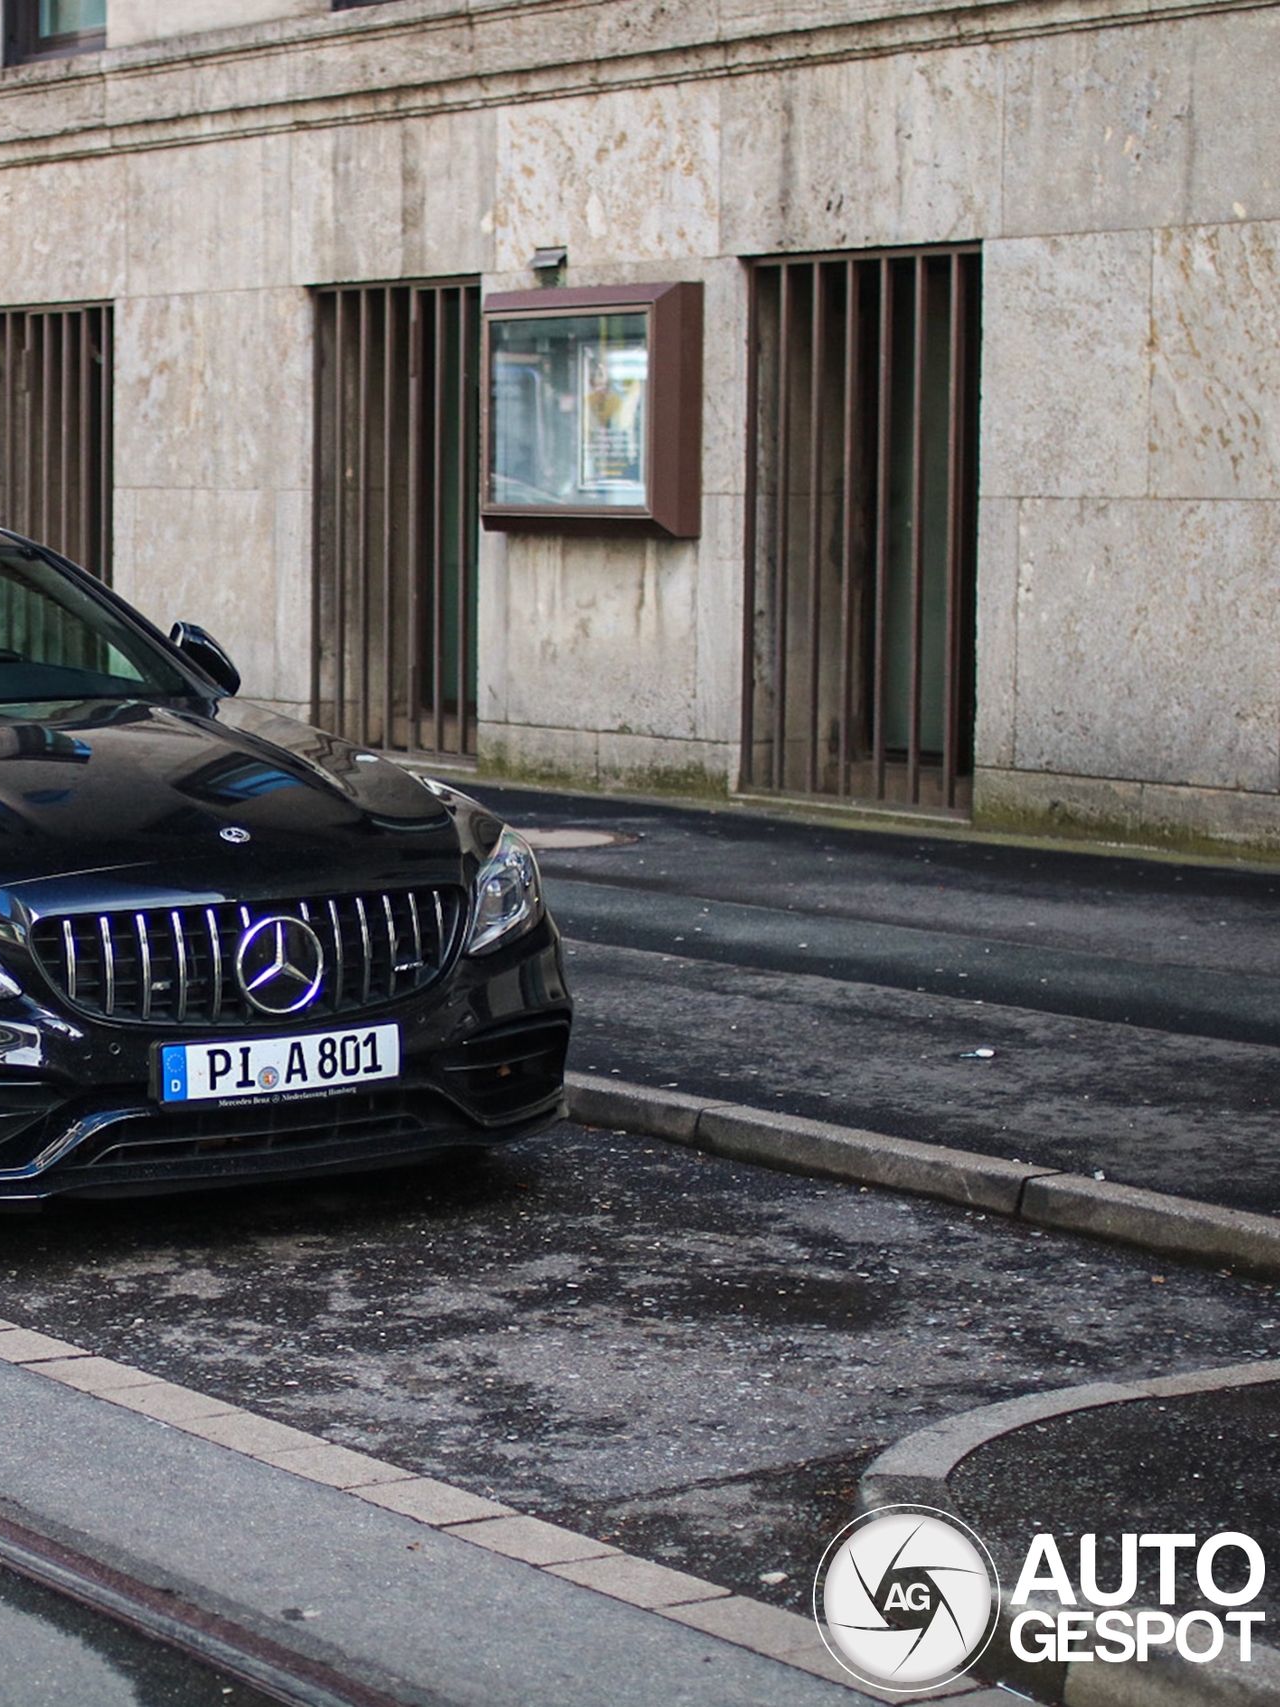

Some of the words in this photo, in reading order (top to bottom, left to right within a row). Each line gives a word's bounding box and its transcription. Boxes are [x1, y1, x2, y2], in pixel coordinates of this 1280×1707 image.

[207, 1046, 256, 1091] PI
[285, 1041, 308, 1084] A
[318, 1032, 382, 1079] 801
[171, 1079, 181, 1093] D
